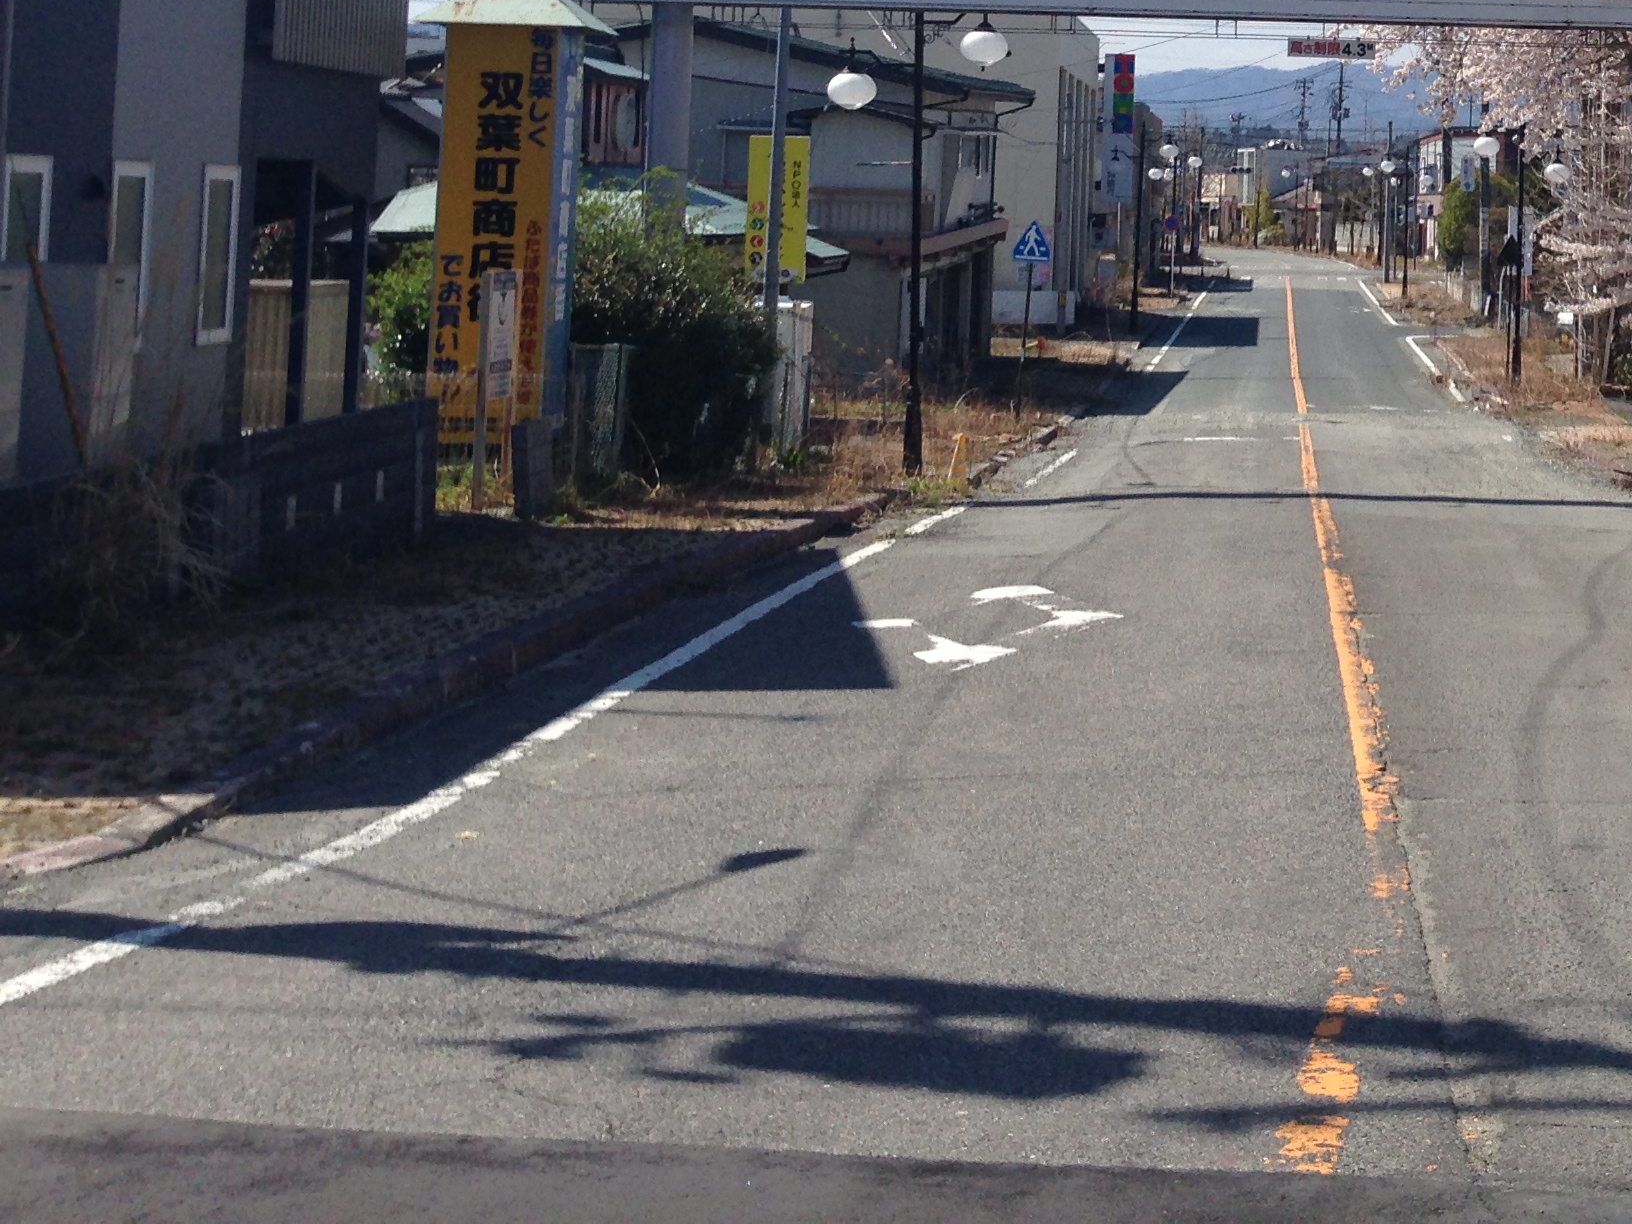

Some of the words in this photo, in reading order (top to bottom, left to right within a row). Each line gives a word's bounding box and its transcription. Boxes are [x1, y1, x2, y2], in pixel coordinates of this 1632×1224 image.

[527, 27, 557, 148] 毎日楽しく
